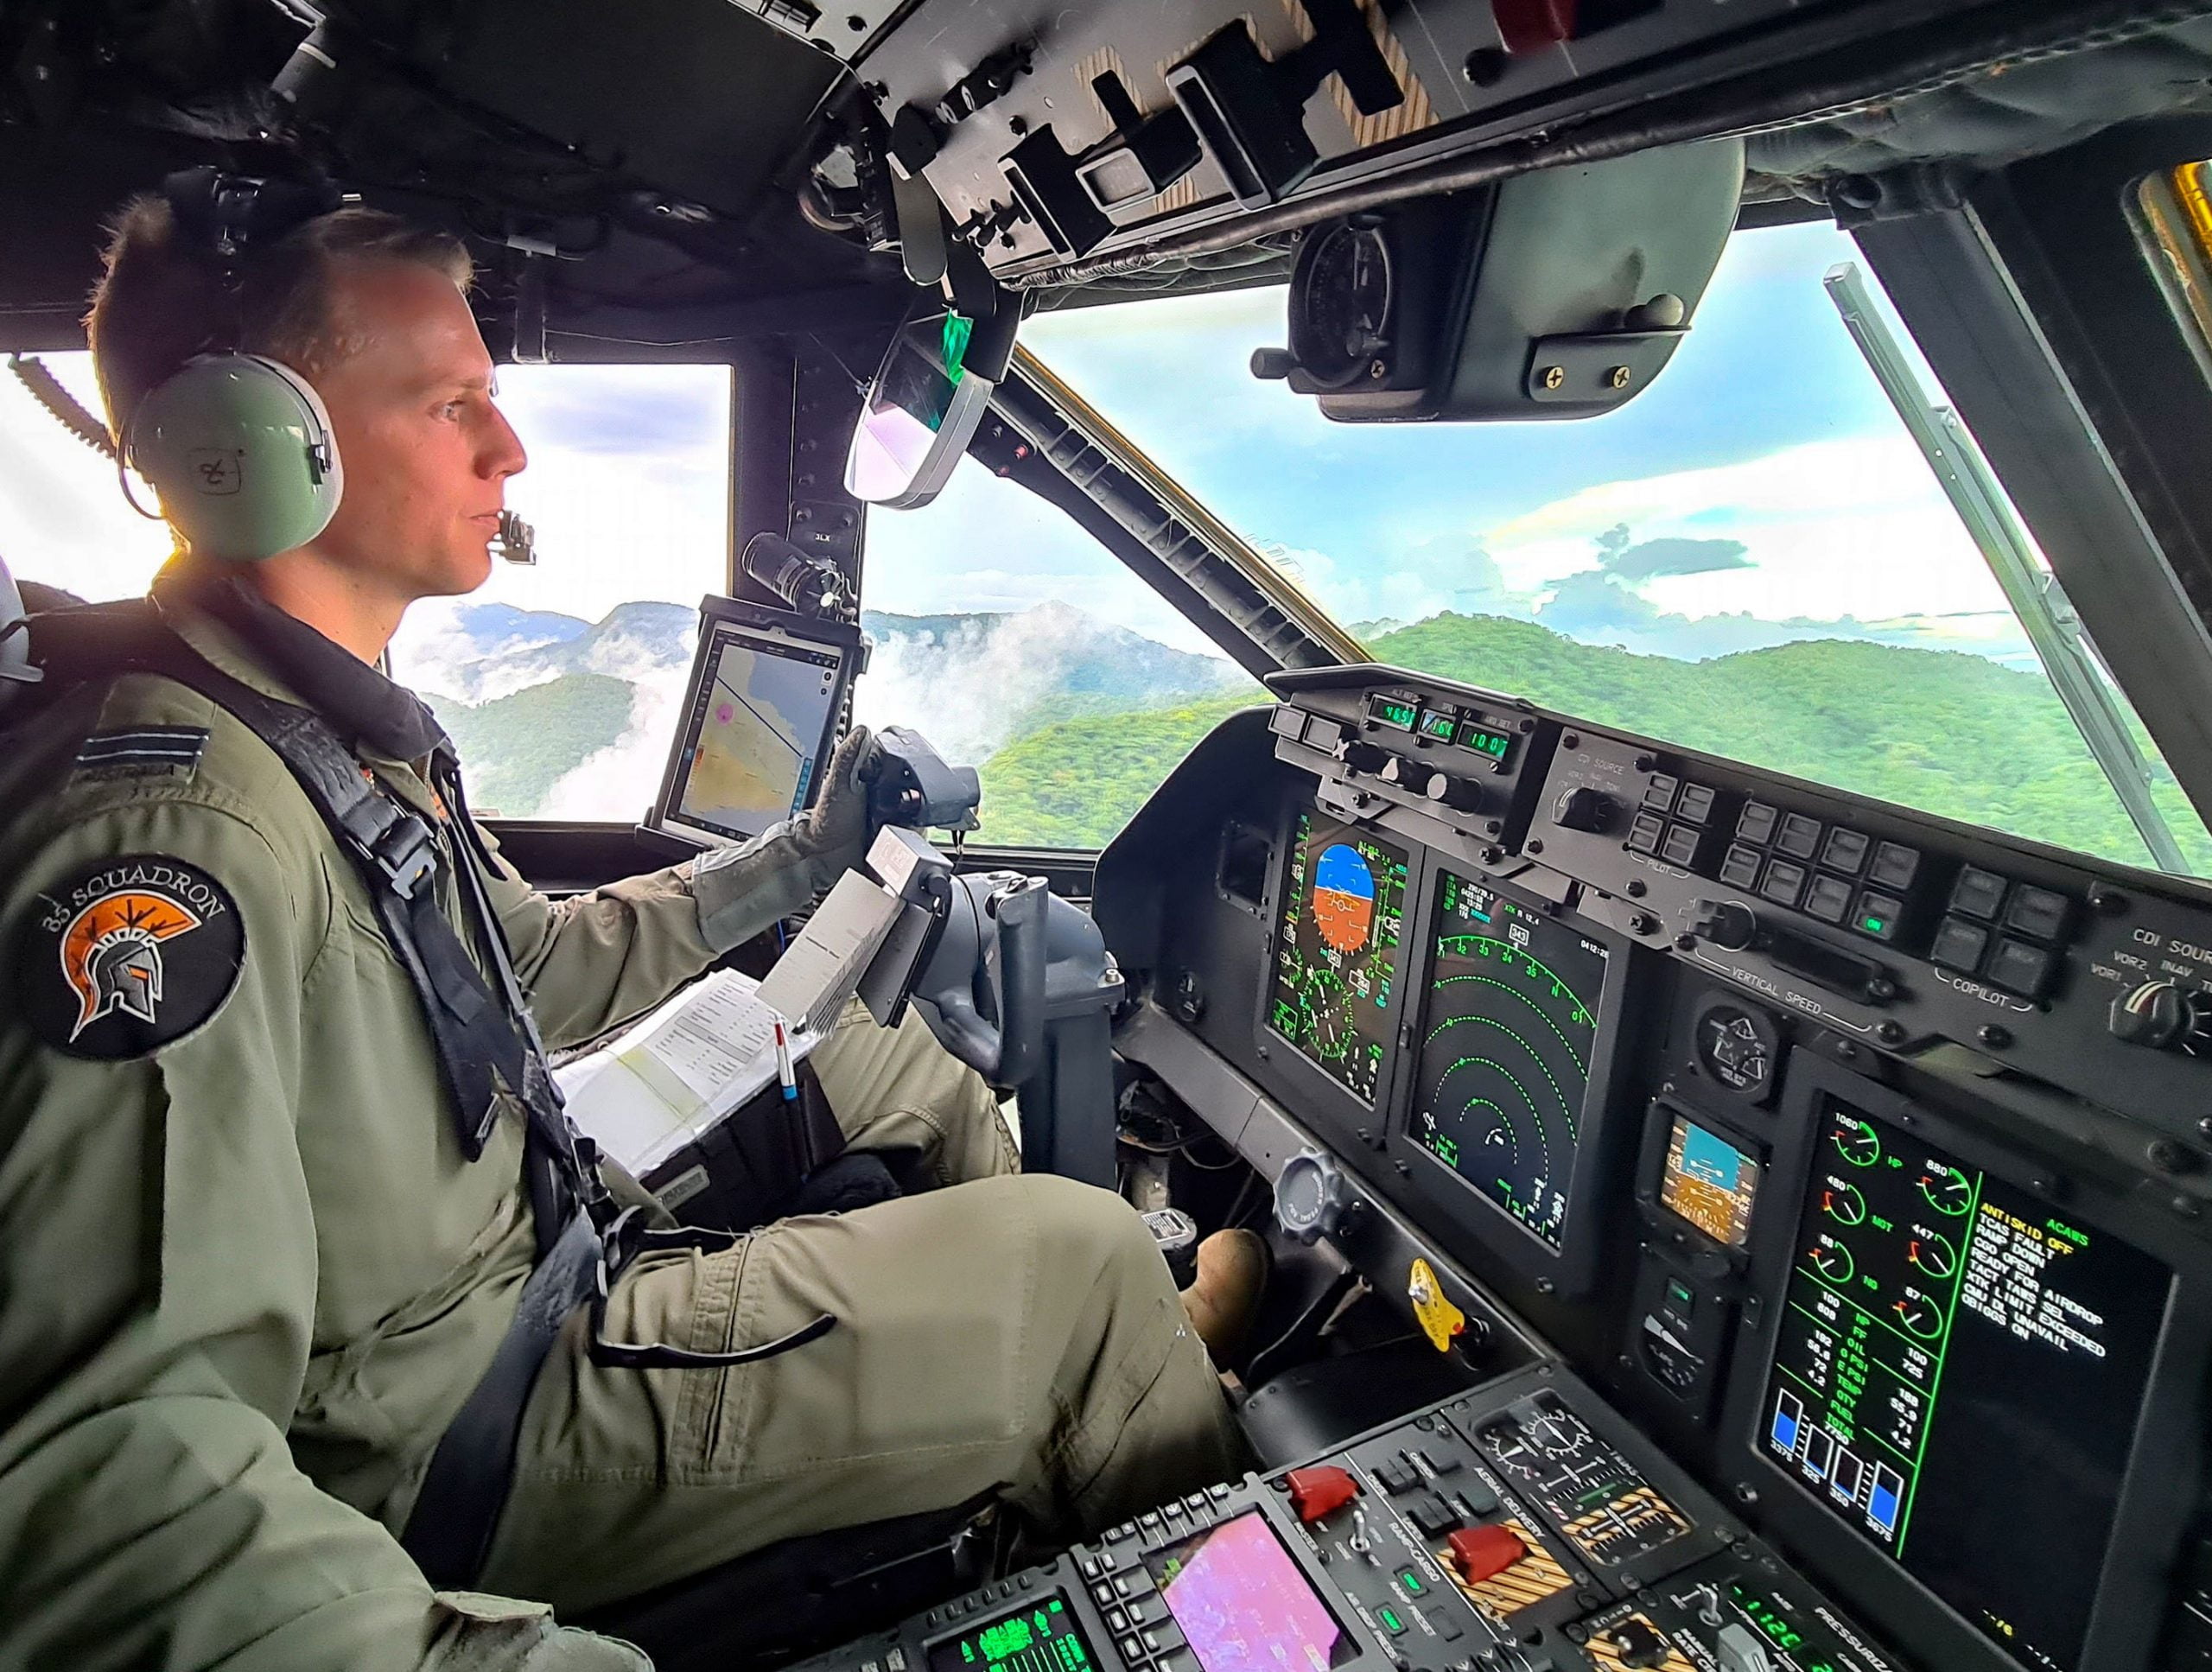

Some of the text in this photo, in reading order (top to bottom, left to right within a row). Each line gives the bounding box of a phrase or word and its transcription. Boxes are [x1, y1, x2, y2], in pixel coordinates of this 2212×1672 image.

[1593, 758, 1624, 775] SOURCE
[1647, 859, 1671, 874] PILOT
[72, 865, 226, 919] SQUADRON
[1511, 927, 1527, 941] 343
[1866, 917, 1883, 931] ON
[2133, 928, 2160, 947] CDI
[1457, 942, 1466, 955] 32
[1478, 944, 1489, 956] 33
[1502, 951, 1513, 963] 34
[1526, 965, 1537, 977] 35
[2113, 951, 2148, 971] VOR2
[2090, 963, 2122, 982] VOR1
[1731, 965, 1822, 1015] VERTICAL SPEED
[1952, 977, 2011, 1008] COPILOT
[1835, 1113, 1858, 1130] 1060
[1926, 1160, 1948, 1176] 880
[1827, 1175, 1846, 1191] 480
[1912, 1224, 1934, 1239] 447
[1980, 1202, 2073, 1255] ANTISKID OFF
[1980, 1212, 2056, 1260] TCAS FAULT
[2047, 1219, 2088, 1246] ACAWS
[1974, 1237, 2035, 1276] CGO OPEN
[1975, 1224, 2045, 1268] RAMP DOWN
[1904, 1287, 1921, 1300] 87
[1969, 1259, 2066, 1322] TACT TAWS SEL
[1970, 1247, 2104, 1326] READY FOR AIRDROP
[1822, 1291, 1840, 1308] 100
[1961, 1294, 2030, 1340] OBIGGS ON
[1966, 1270, 2106, 1357] XTK LIMIT EXCEEDED
[1992, 1298, 2007, 1315] DL
[2014, 1311, 2069, 1351] UNAVAIL
[1847, 1338, 1866, 1357] OIL
[1907, 1347, 1928, 1366] 100
[1814, 1357, 1827, 1373] 72
[1837, 1360, 1866, 1385] E PSI
[1850, 1354, 1868, 1373] PSI
[1902, 1358, 1923, 1379] 725
[1807, 1370, 1826, 1387] 4.2
[1837, 1374, 1862, 1395] TEMP
[1836, 1390, 1857, 1408] QTY
[1830, 1400, 1854, 1424] FUEL
[1824, 1421, 1849, 1446] 7750
[1827, 1412, 1855, 1441] TOTAL
[1891, 1431, 1911, 1449] 4.2
[1770, 1440, 1793, 1462] 3375
[1367, 1473, 1388, 1496] CHUTE
[1802, 1465, 1821, 1484] 325
[1474, 1467, 1547, 1538] AERIAL DELIVERY
[1829, 1487, 1849, 1507] 350
[1294, 1521, 1319, 1550] MASTER
[1866, 1516, 1892, 1542] 3675
[1389, 1581, 1411, 1604] RAMP
[1408, 1605, 1436, 1636] PRESET
[1344, 1592, 1360, 1606] AIR
[1356, 1604, 1377, 1629] DROP
[1373, 1630, 1397, 1659] PRESS
[1672, 1631, 1698, 1659] RATE
